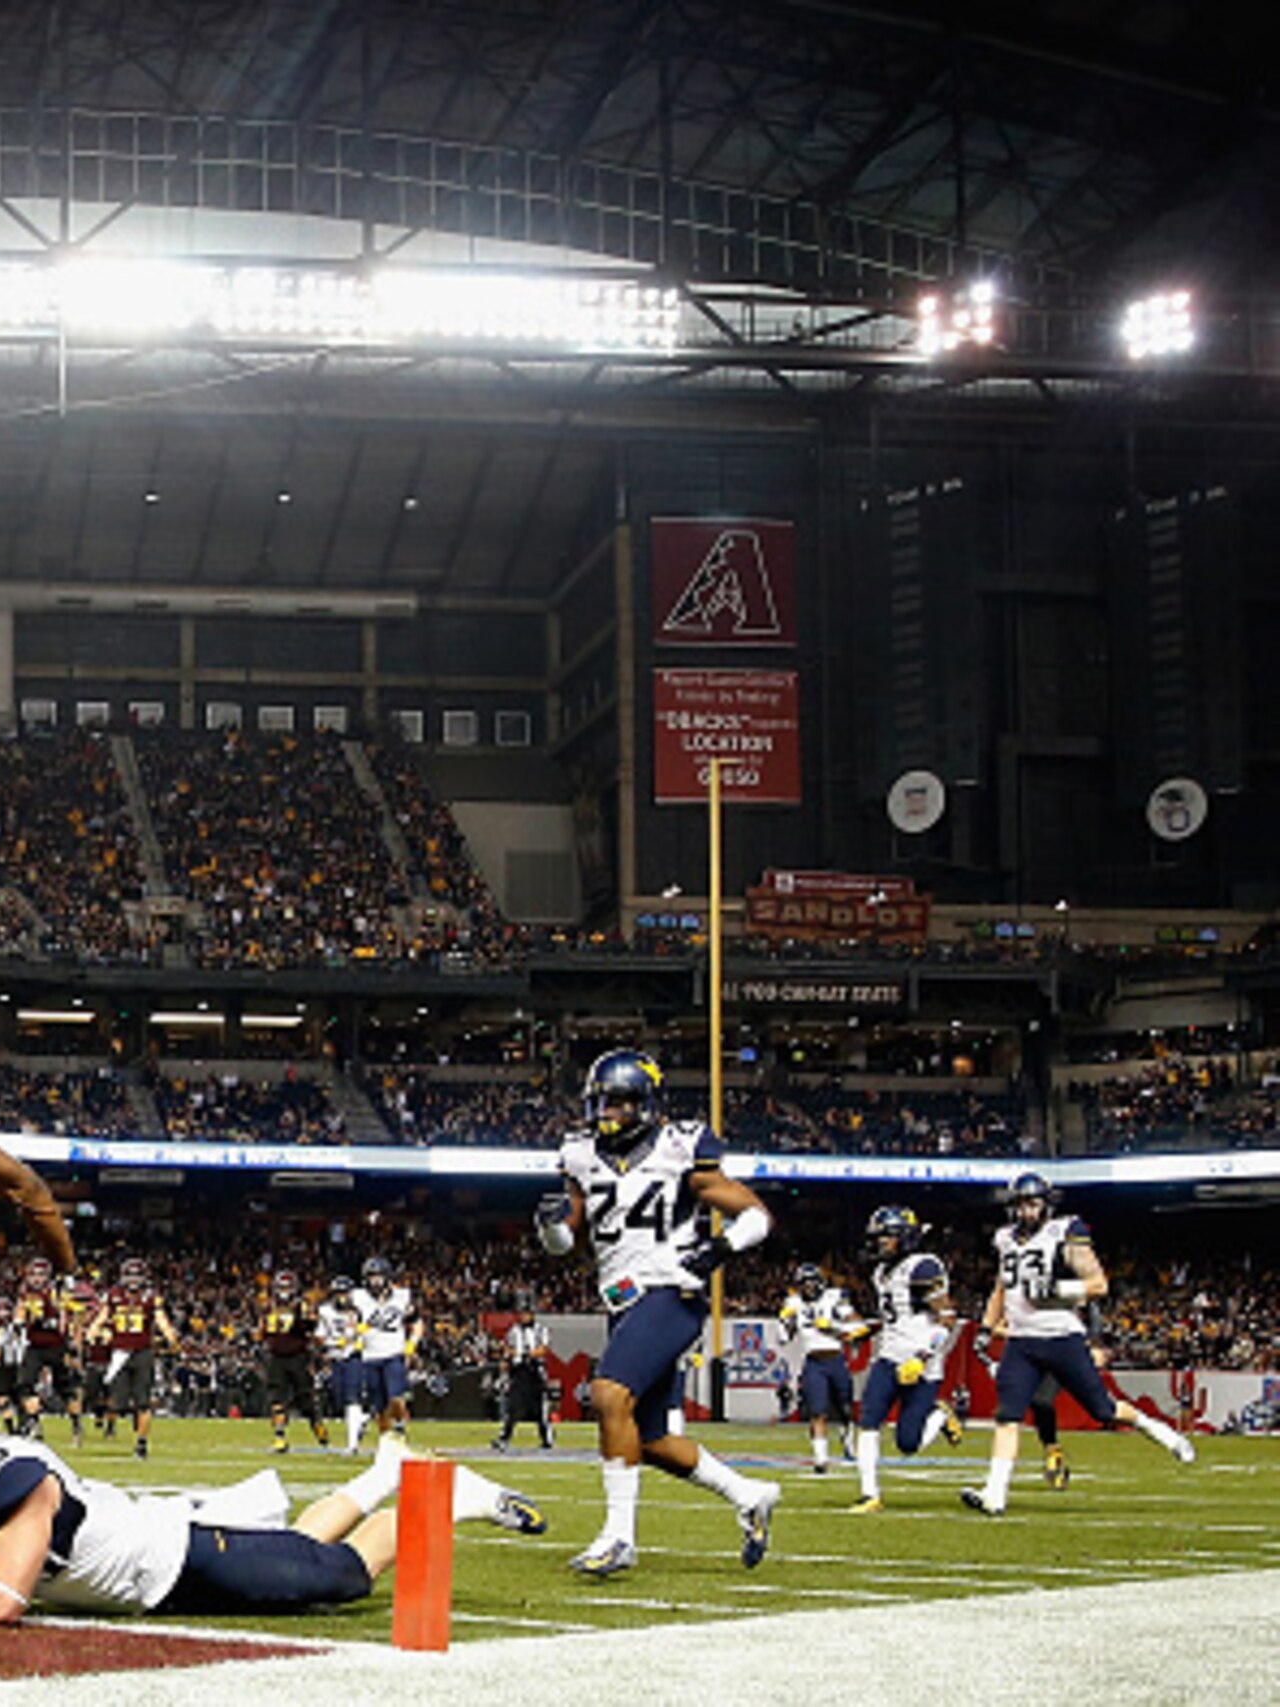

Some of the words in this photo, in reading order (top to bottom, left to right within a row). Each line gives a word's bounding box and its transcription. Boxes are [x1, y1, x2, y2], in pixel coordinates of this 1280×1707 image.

[683, 734, 773, 751] LOCATION
[753, 901, 923, 927] SANDLOT
[590, 1181, 668, 1241] 24
[1004, 1249, 1046, 1289] 93
[368, 1306, 400, 1333] 42
